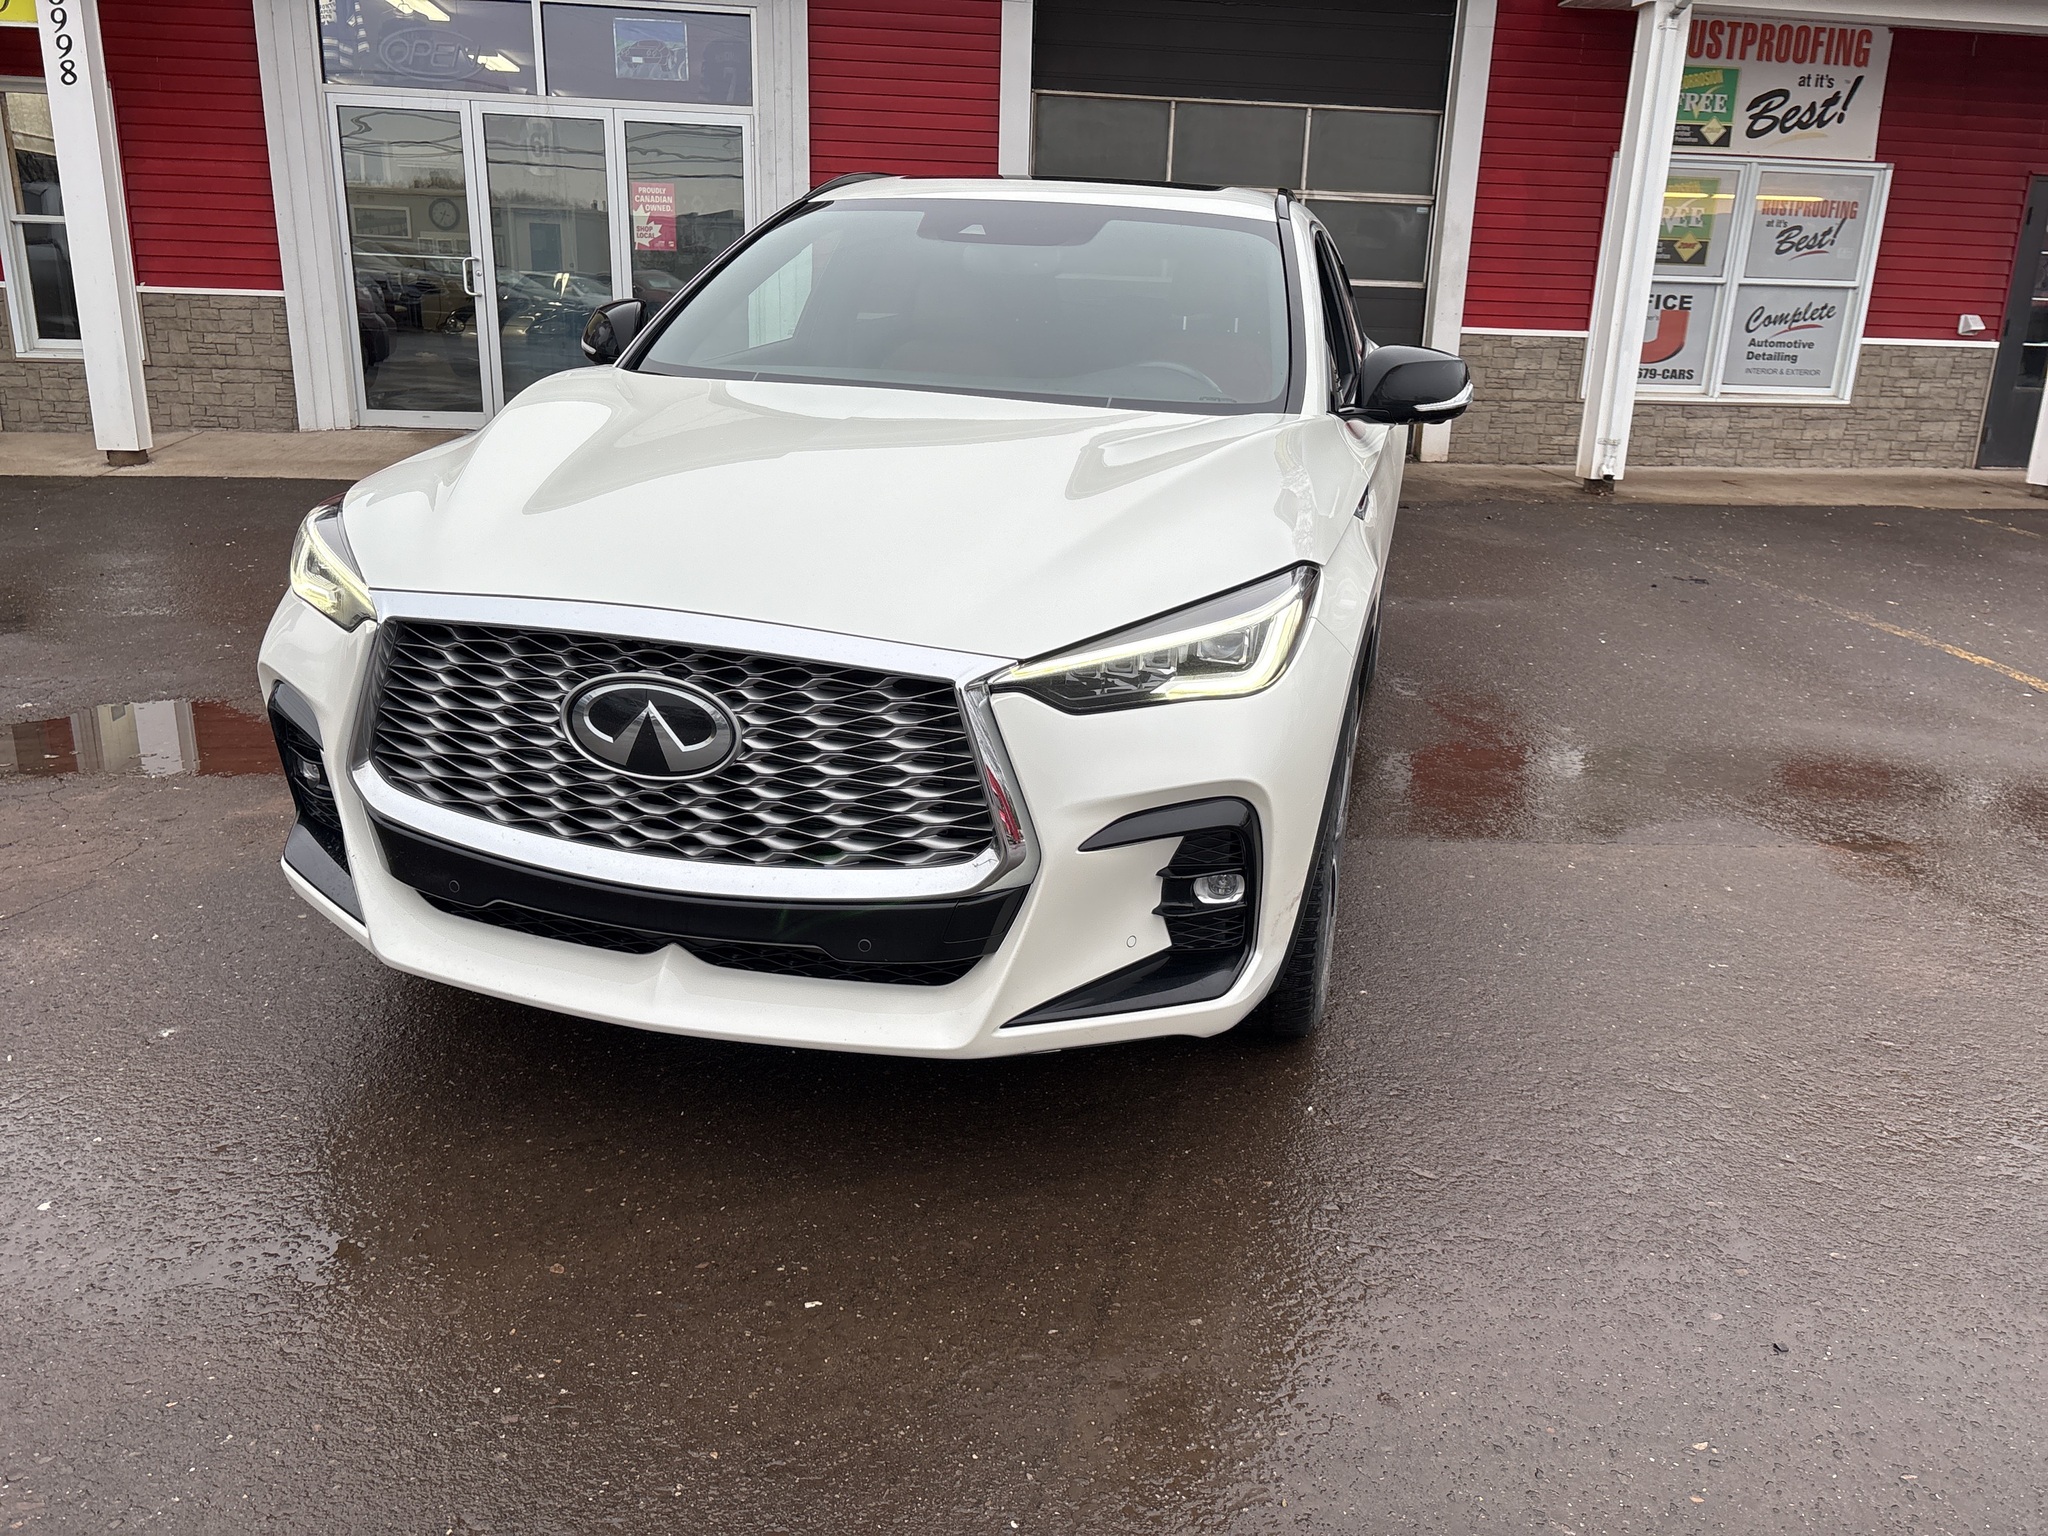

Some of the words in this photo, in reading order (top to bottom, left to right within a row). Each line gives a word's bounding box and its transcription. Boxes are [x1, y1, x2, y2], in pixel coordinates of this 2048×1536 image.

[48, 0, 78, 86] 998
[385, 38, 481, 68] OPEN
[1798, 74, 1811, 87] at
[1815, 74, 1835, 88] it's
[1745, 75, 1864, 139] Best!
[634, 195, 673, 203] CANADIAN
[645, 204, 673, 212] OWNED.
[1761, 199, 1859, 219] RUSTPROOFING
[1776, 220, 1788, 228] it's
[1775, 217, 1847, 255] Best!
[1745, 301, 1836, 333] Complete
[1748, 338, 1815, 349] Automotive
[1746, 351, 1798, 364] Detailing
[1745, 367, 1778, 375] INTERIOR
[1786, 368, 1821, 376] EXTERIOR
